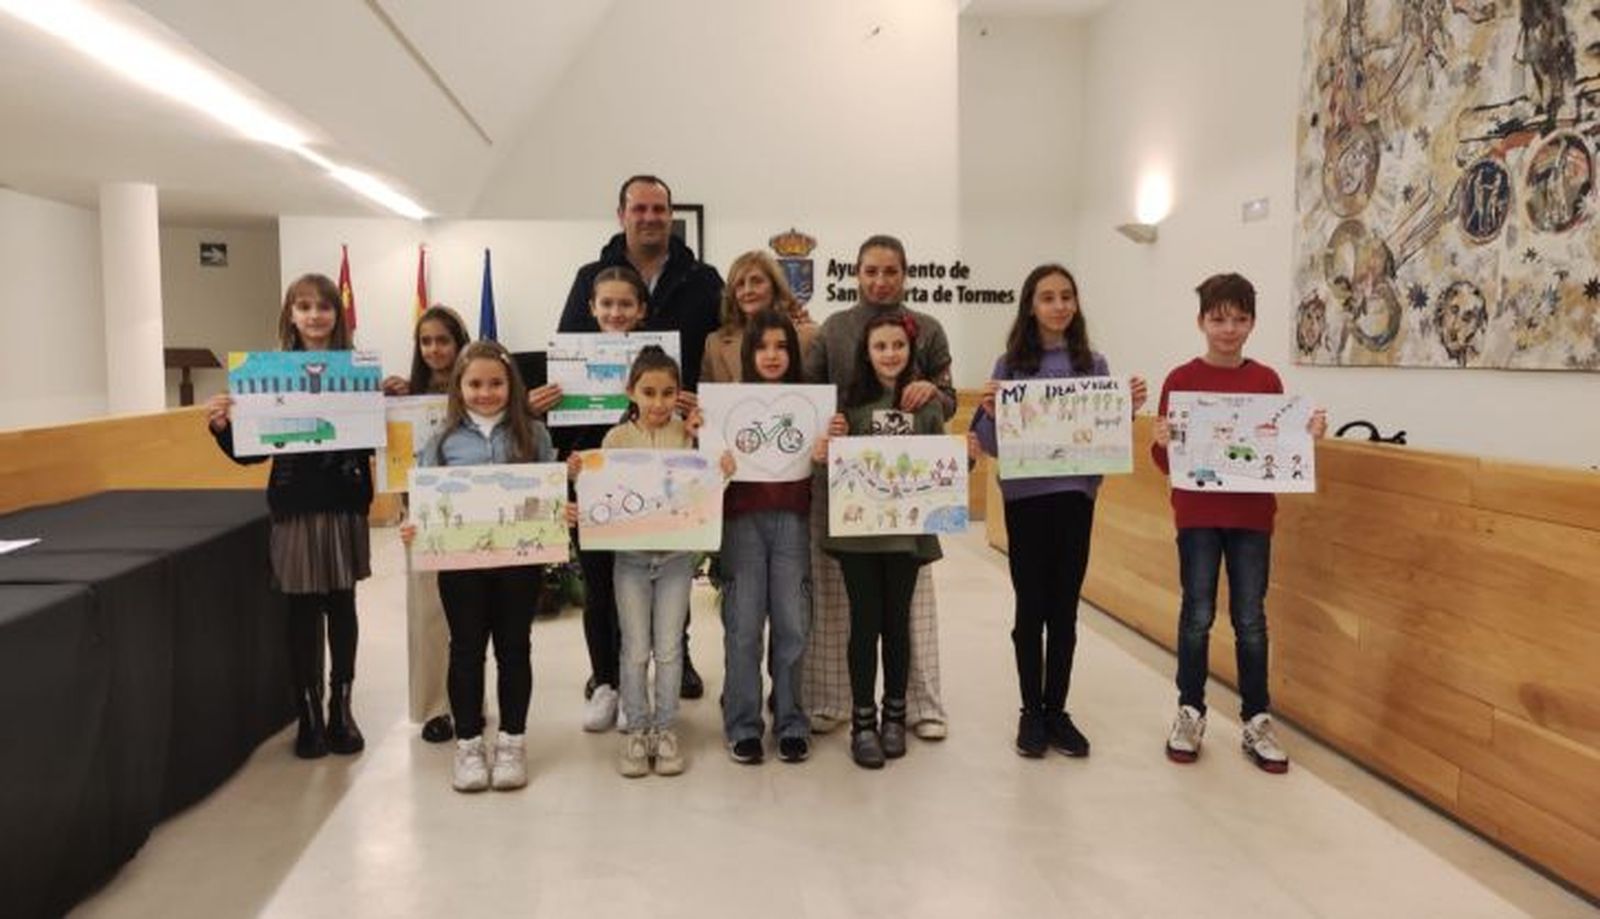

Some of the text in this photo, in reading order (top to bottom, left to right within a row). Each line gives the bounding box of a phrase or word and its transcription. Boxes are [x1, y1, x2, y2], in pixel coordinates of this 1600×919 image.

[827, 259, 970, 281] Ayuento de
[827, 283, 1014, 303] San rta de Tormes
[1002, 384, 1027, 404] MY
